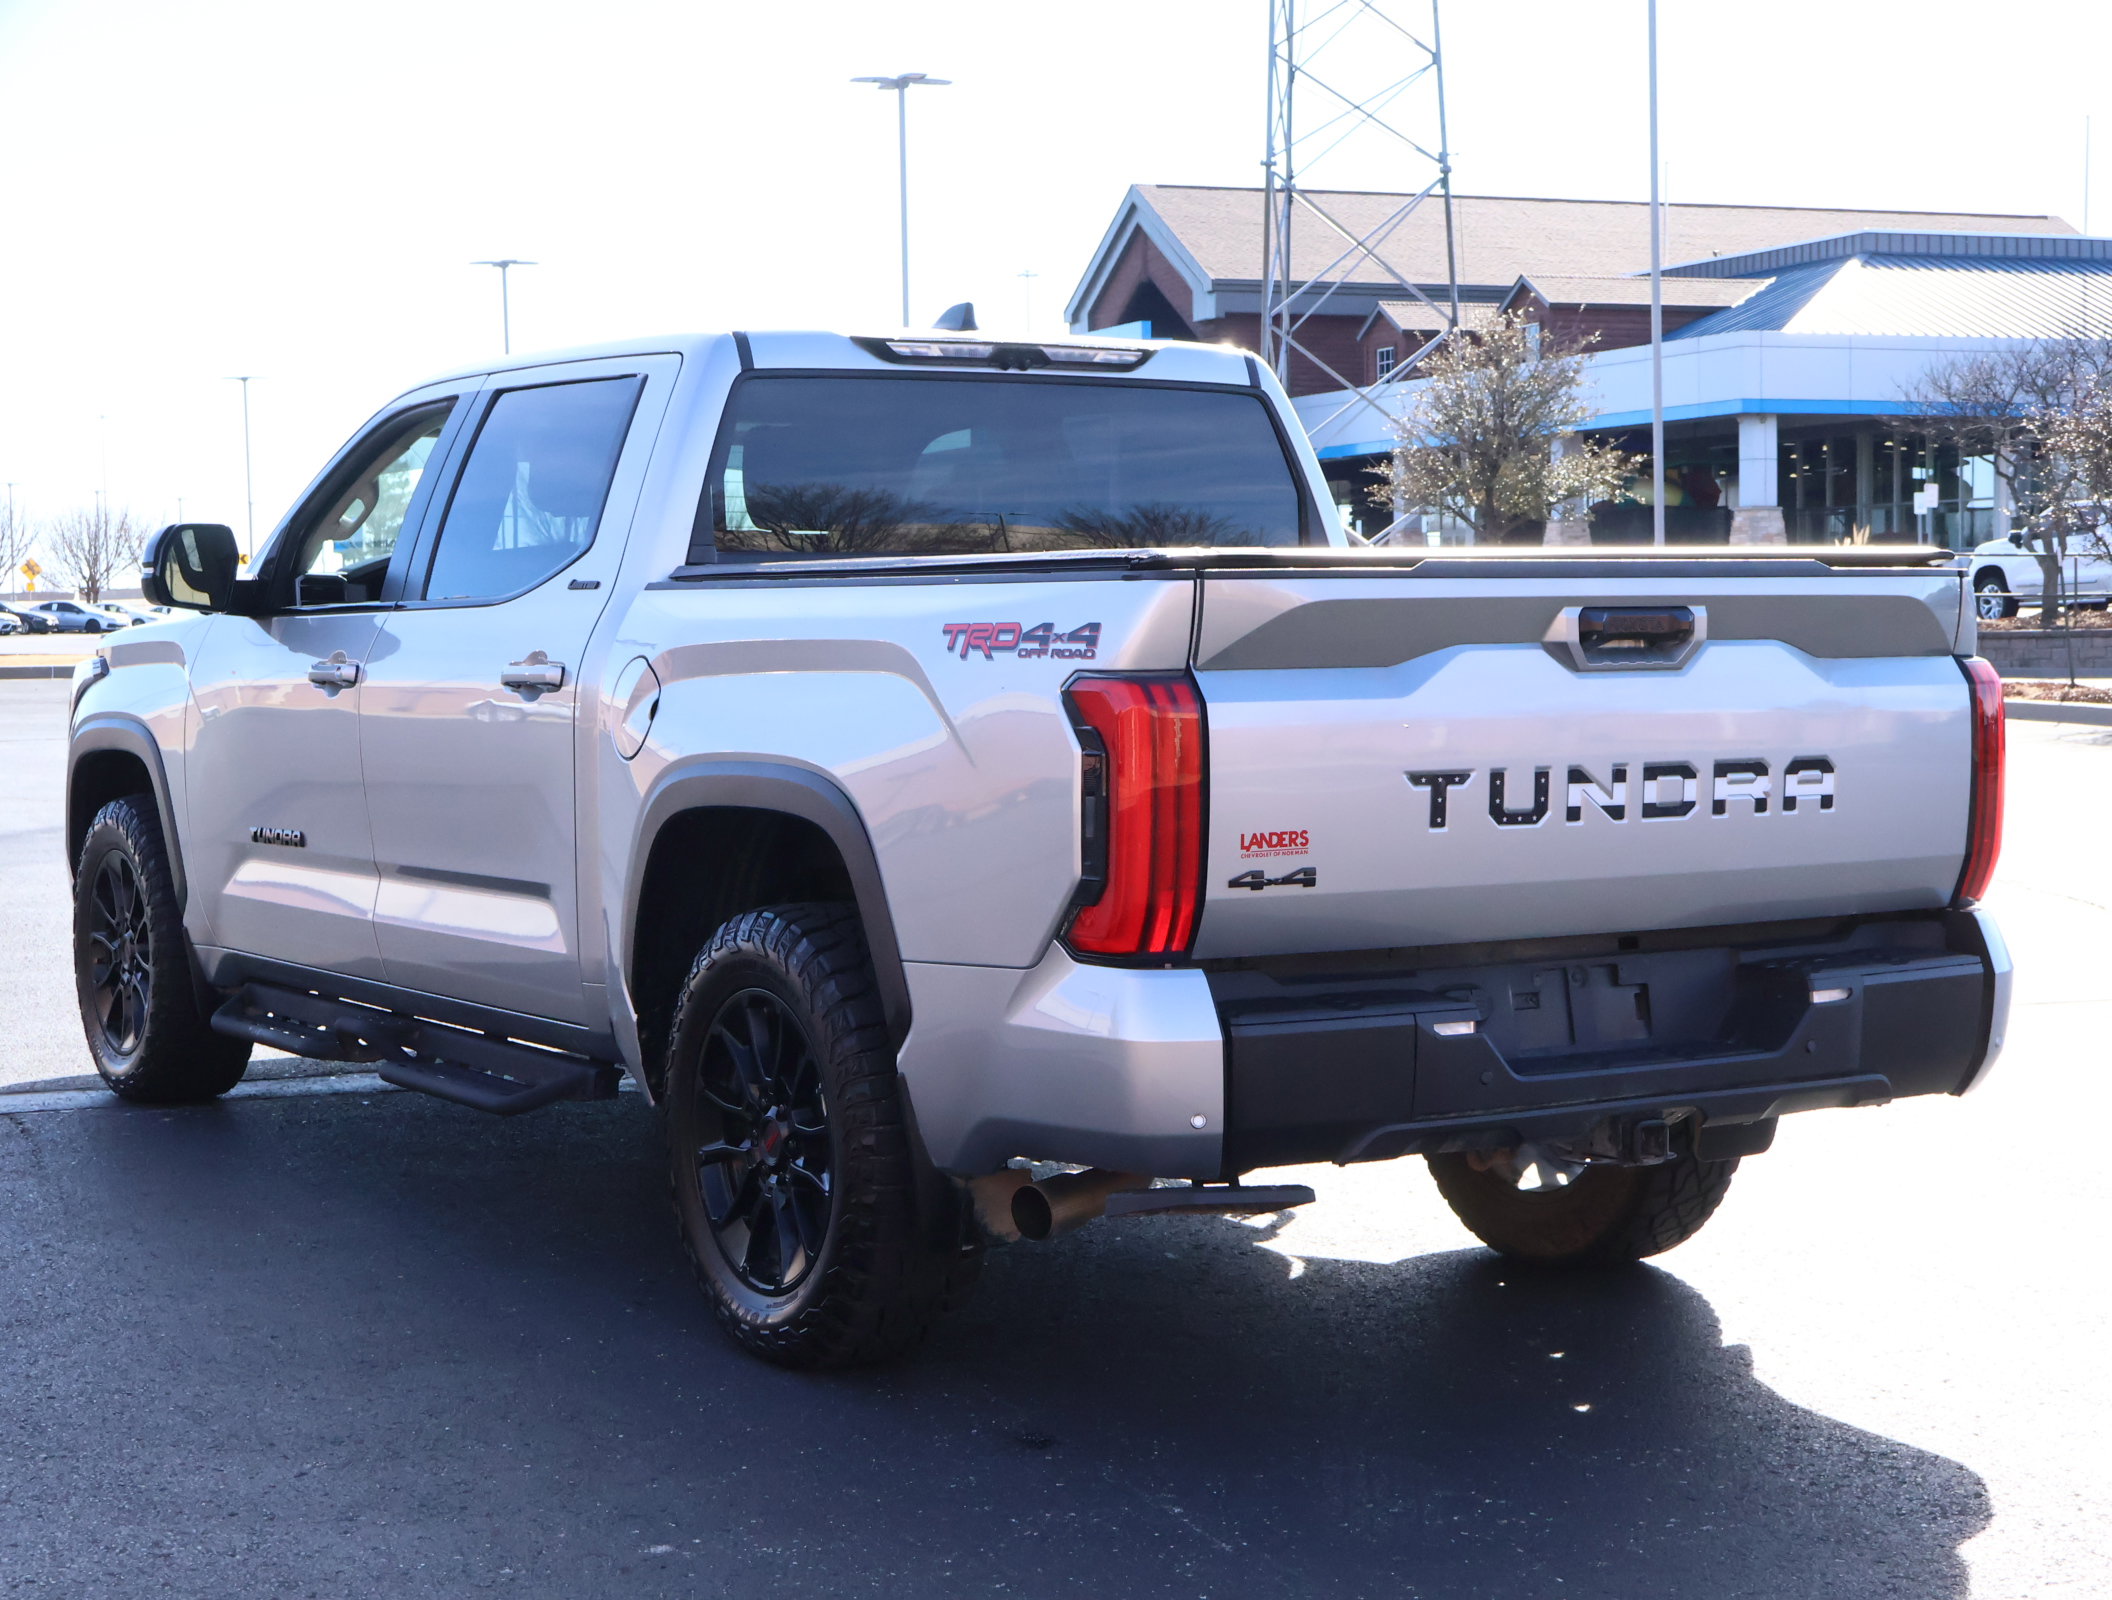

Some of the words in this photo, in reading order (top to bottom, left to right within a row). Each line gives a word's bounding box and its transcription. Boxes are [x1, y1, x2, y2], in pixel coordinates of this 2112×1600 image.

[942, 622, 1022, 661] TRD
[1017, 648, 1049, 659] OFF
[1050, 648, 1096, 660] ROAD
[1403, 755, 1836, 832] TUNDRA
[1240, 830, 1310, 852] LANDERS
[1240, 851, 1272, 859] CHEVROLET
